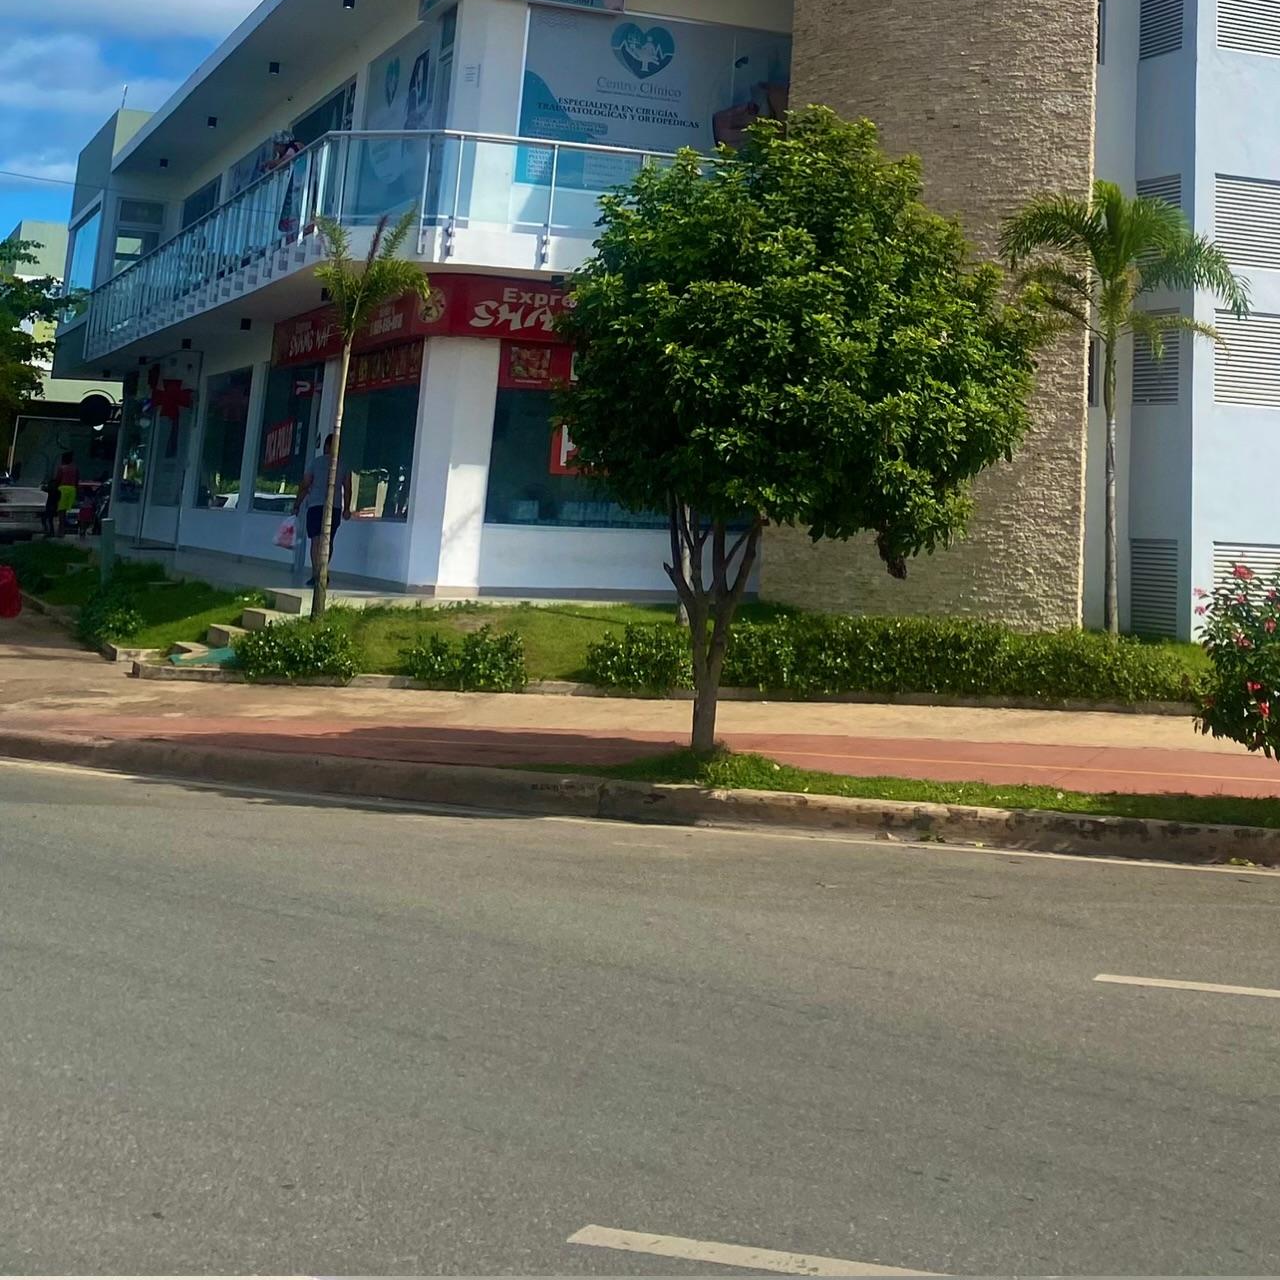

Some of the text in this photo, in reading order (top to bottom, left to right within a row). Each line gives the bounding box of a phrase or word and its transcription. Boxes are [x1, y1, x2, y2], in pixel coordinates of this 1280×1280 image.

[558, 96, 620, 112] ESPECIALISTA
[621, 104, 635, 114] EN
[629, 113, 636, 121] Y
